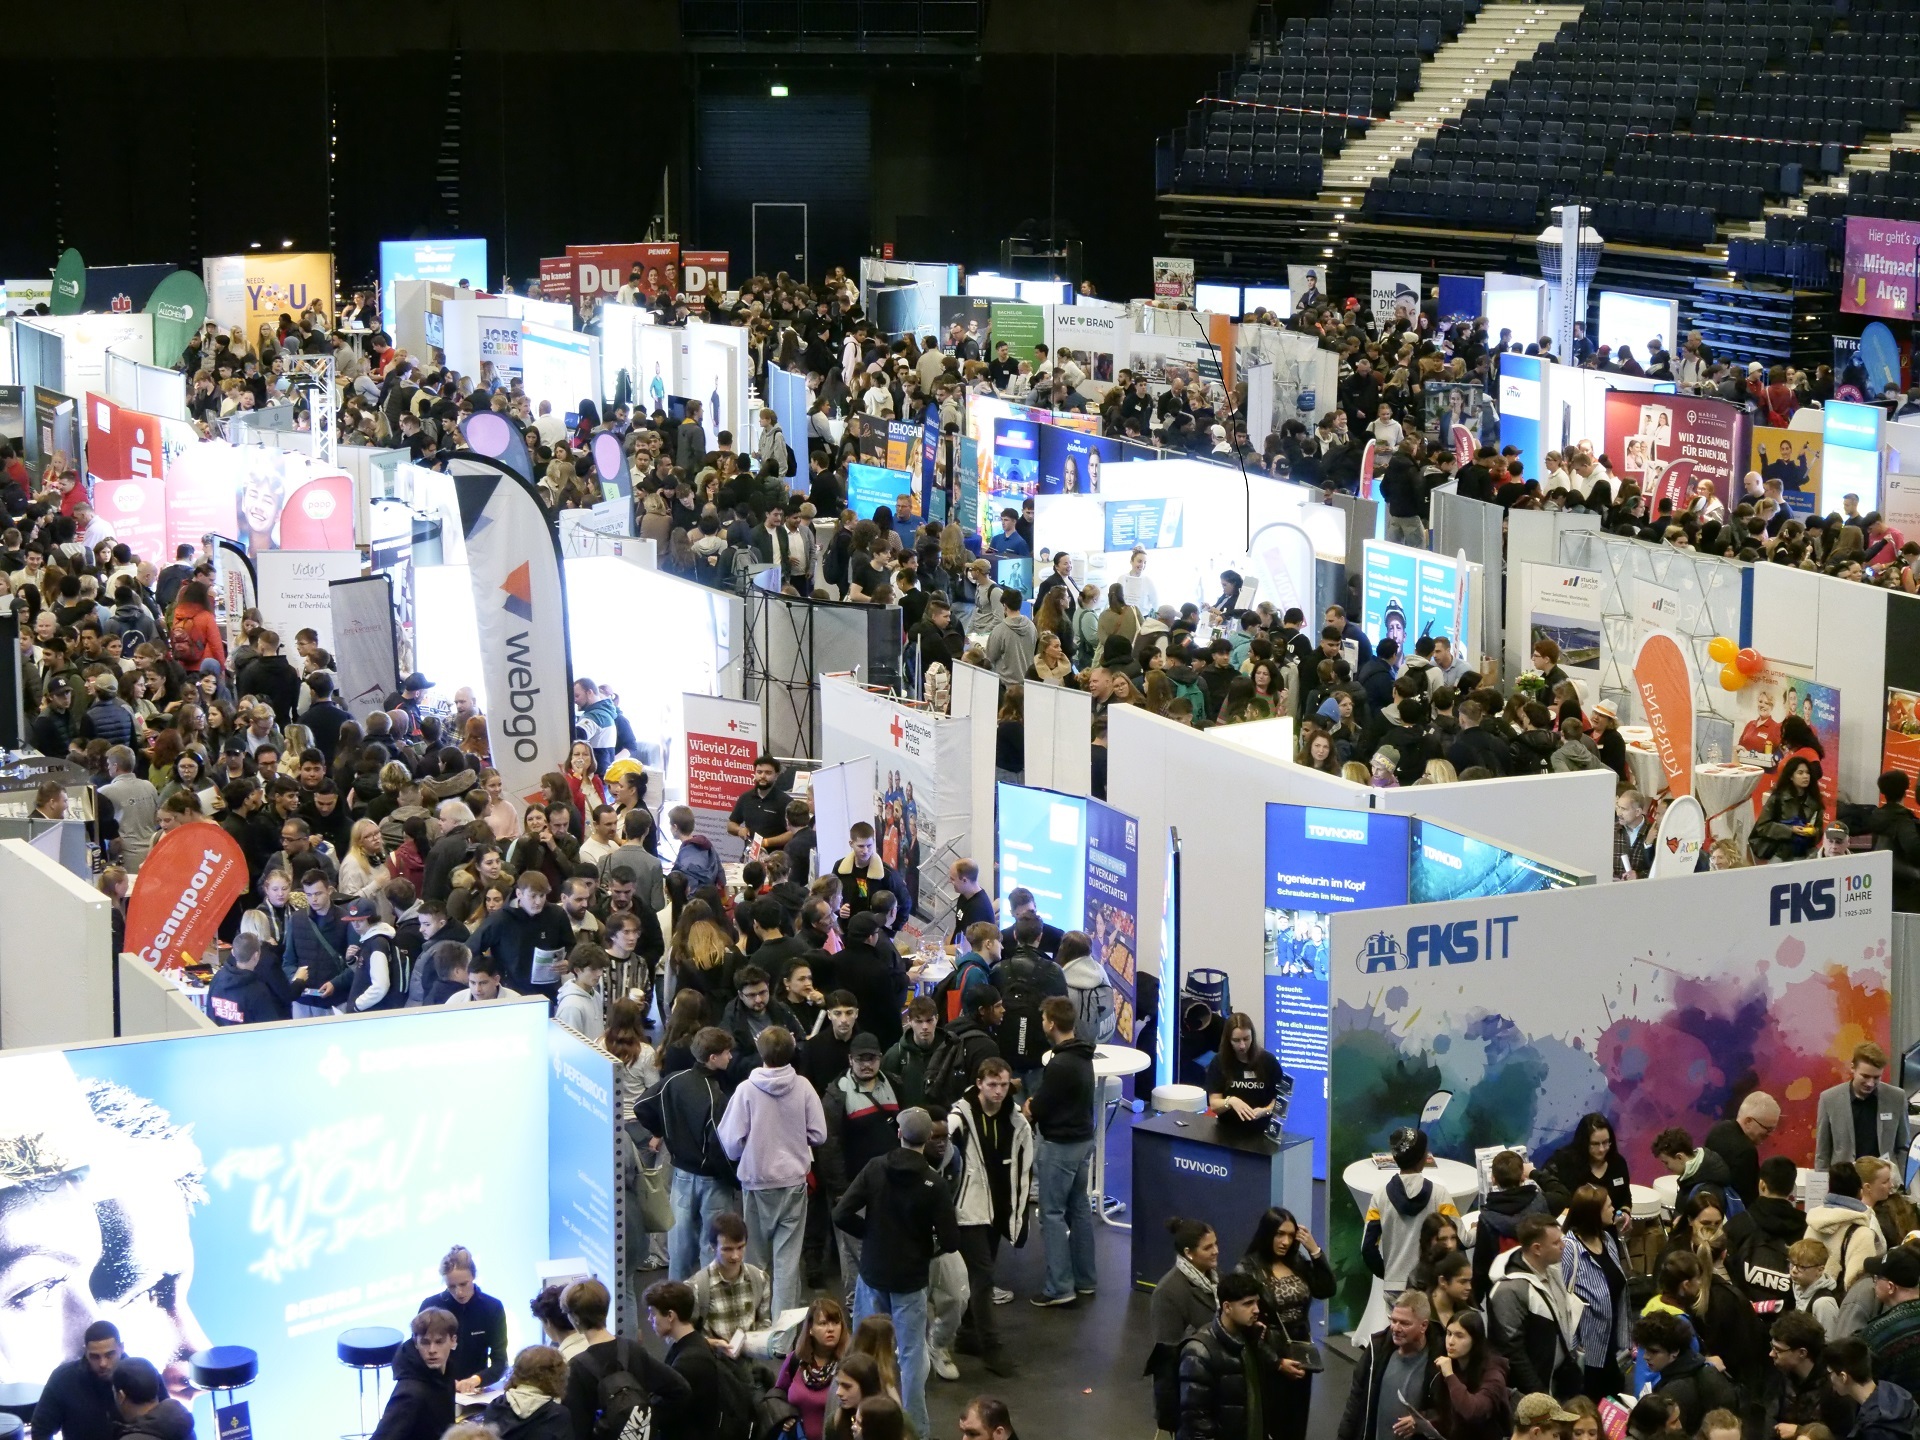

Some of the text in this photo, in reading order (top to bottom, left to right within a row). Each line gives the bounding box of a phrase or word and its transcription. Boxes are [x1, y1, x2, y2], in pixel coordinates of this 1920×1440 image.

[1869, 229, 1884, 242] Hier
[1886, 231, 1910, 245] geht's
[1155, 261, 1192, 269] JOBWOCHE
[578, 264, 621, 293] Du
[1373, 289, 1396, 299] DANK
[1876, 281, 1908, 301] Area
[159, 308, 187, 319] ALLOHEIM
[1058, 316, 1114, 329] WE BRAND
[483, 328, 518, 343] JOBS
[496, 342, 518, 351] BUNT
[1506, 388, 1522, 398] vhw
[889, 421, 918, 436] DEHOGA
[1678, 432, 1731, 450] WIR ZUSAMMEN
[1682, 445, 1728, 463] FÜR EINEN JOB,
[1890, 481, 1901, 489] EF
[293, 563, 325, 576] Victor's
[299, 600, 332, 609] Überblick
[503, 631, 541, 763] webgo
[905, 719, 932, 739] Deutsches
[905, 730, 920, 745] Rotes
[689, 739, 750, 758] Wieviel Zeit
[905, 742, 920, 757] Kreuz
[690, 755, 755, 772] gibst du deinem
[690, 767, 756, 786] Irgendwann?
[1309, 825, 1365, 841] TÜVNORD
[1090, 837, 1099, 848] MIT
[1096, 866, 1119, 885] VERKAUF
[1278, 872, 1366, 892] Ingenieur:in im Kopf
[1845, 874, 1872, 891] 100
[1089, 877, 1128, 902] DURCHSTARTEN
[1277, 888, 1319, 899] Schrauber:in
[1330, 894, 1355, 903] Herzen
[1845, 891, 1872, 902] JAHRE
[138, 848, 222, 970] Genuport
[178, 858, 234, 948] MARKETING DISTRIBUTION
[1770, 878, 1836, 926] FKS
[1845, 908, 1872, 917] 1925-2025
[1407, 915, 1519, 970] FKS IT
[1276, 985, 1303, 993] Gesucht:
[563, 1062, 608, 1107] DEPENBROCK
[1230, 1079, 1264, 1089] VNORD
[1174, 1157, 1228, 1177] TÜVNORD
[1744, 1261, 1792, 1292] VANS
